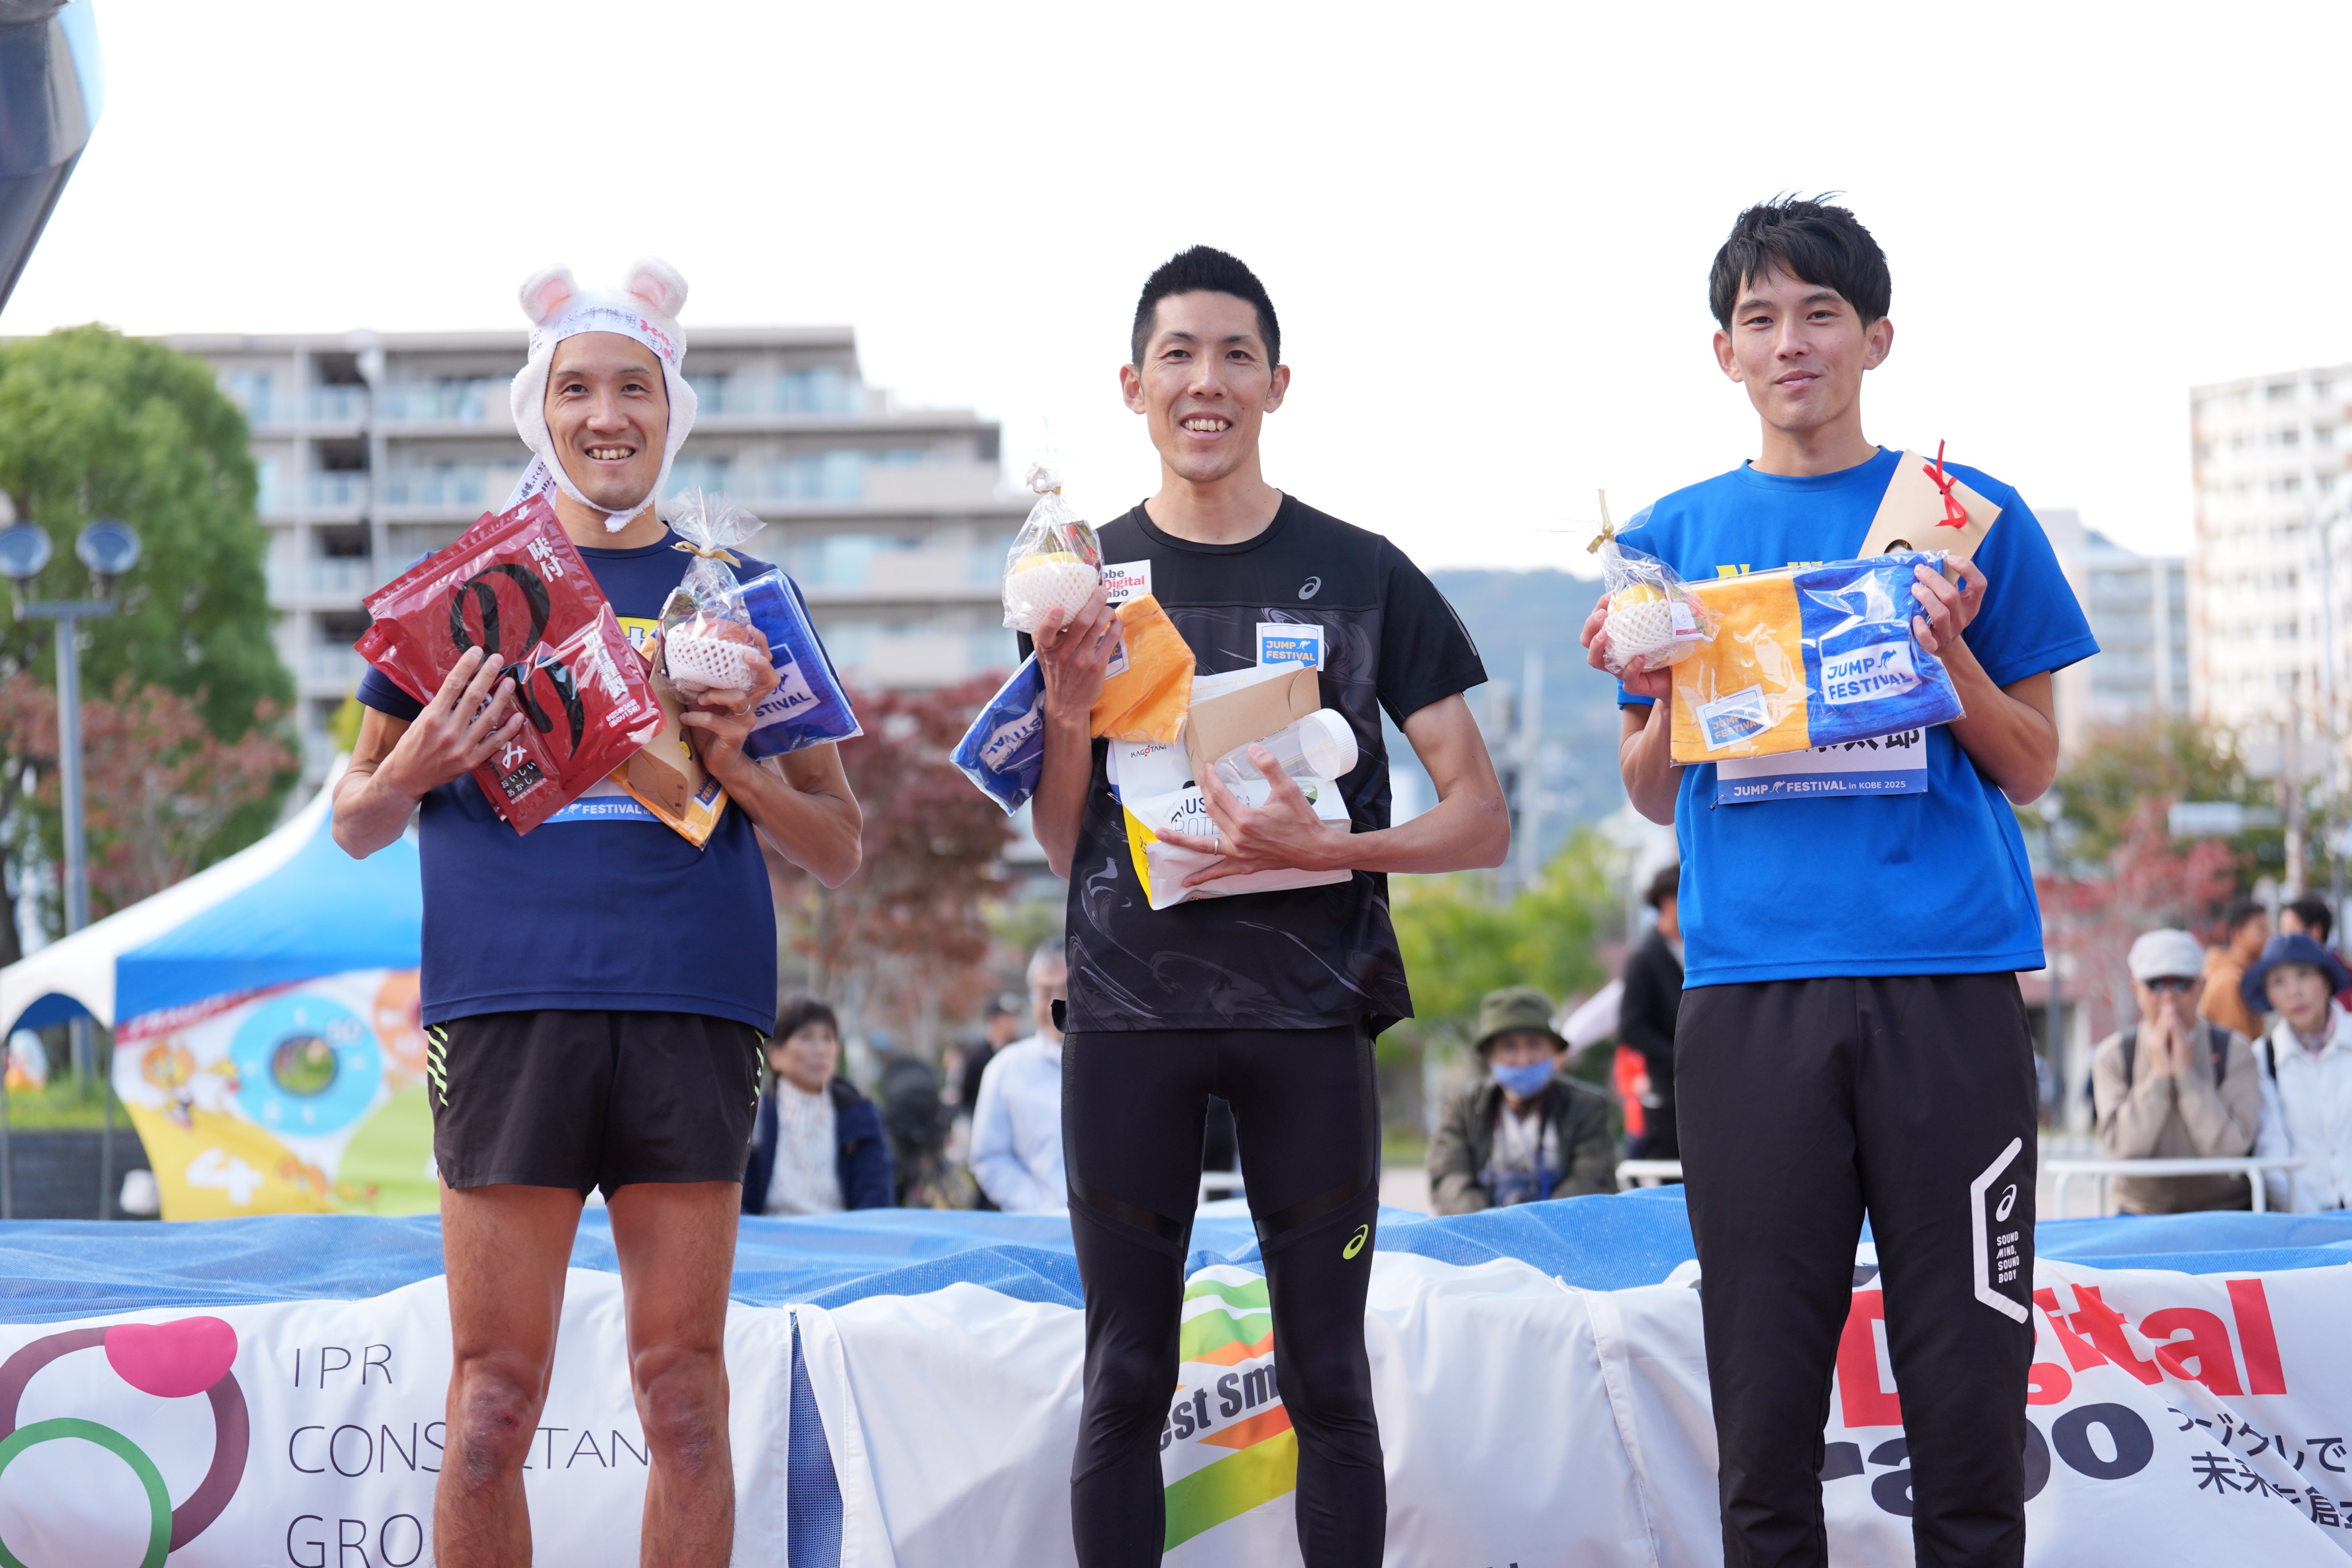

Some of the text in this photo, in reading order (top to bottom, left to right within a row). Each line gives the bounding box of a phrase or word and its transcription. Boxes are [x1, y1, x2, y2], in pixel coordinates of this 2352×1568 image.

[526, 537, 564, 583] 味付
[1105, 575, 1145, 590] Digital
[1266, 640, 1297, 649] JUMP
[1266, 650, 1316, 661] FESTIVAL
[1827, 658, 1875, 680] JUMP
[1828, 673, 1913, 700] FESTIVAL
[754, 691, 811, 717] STIVAL
[986, 717, 1041, 755] STIVAL
[1715, 720, 1760, 739] FESTIVA
[1131, 745, 1166, 758] KAGOTANI
[501, 762, 537, 788] おいしい
[506, 778, 533, 798] あかし
[1734, 784, 1768, 797] JUMP
[1787, 780, 1847, 792] FESTIVAL
[582, 804, 642, 814] FESTIVAL
[1996, 1231, 2018, 1246] SOUND
[1996, 1245, 2017, 1259] MIND,
[1997, 1255, 2019, 1271] SOUND
[1998, 1269, 2016, 1283] BODY
[294, 1344, 392, 1389] IPR
[1159, 1364, 1280, 1452] est Sm
[289, 1421, 648, 1477] CONSTAN
[287, 1514, 423, 1568] GRO
